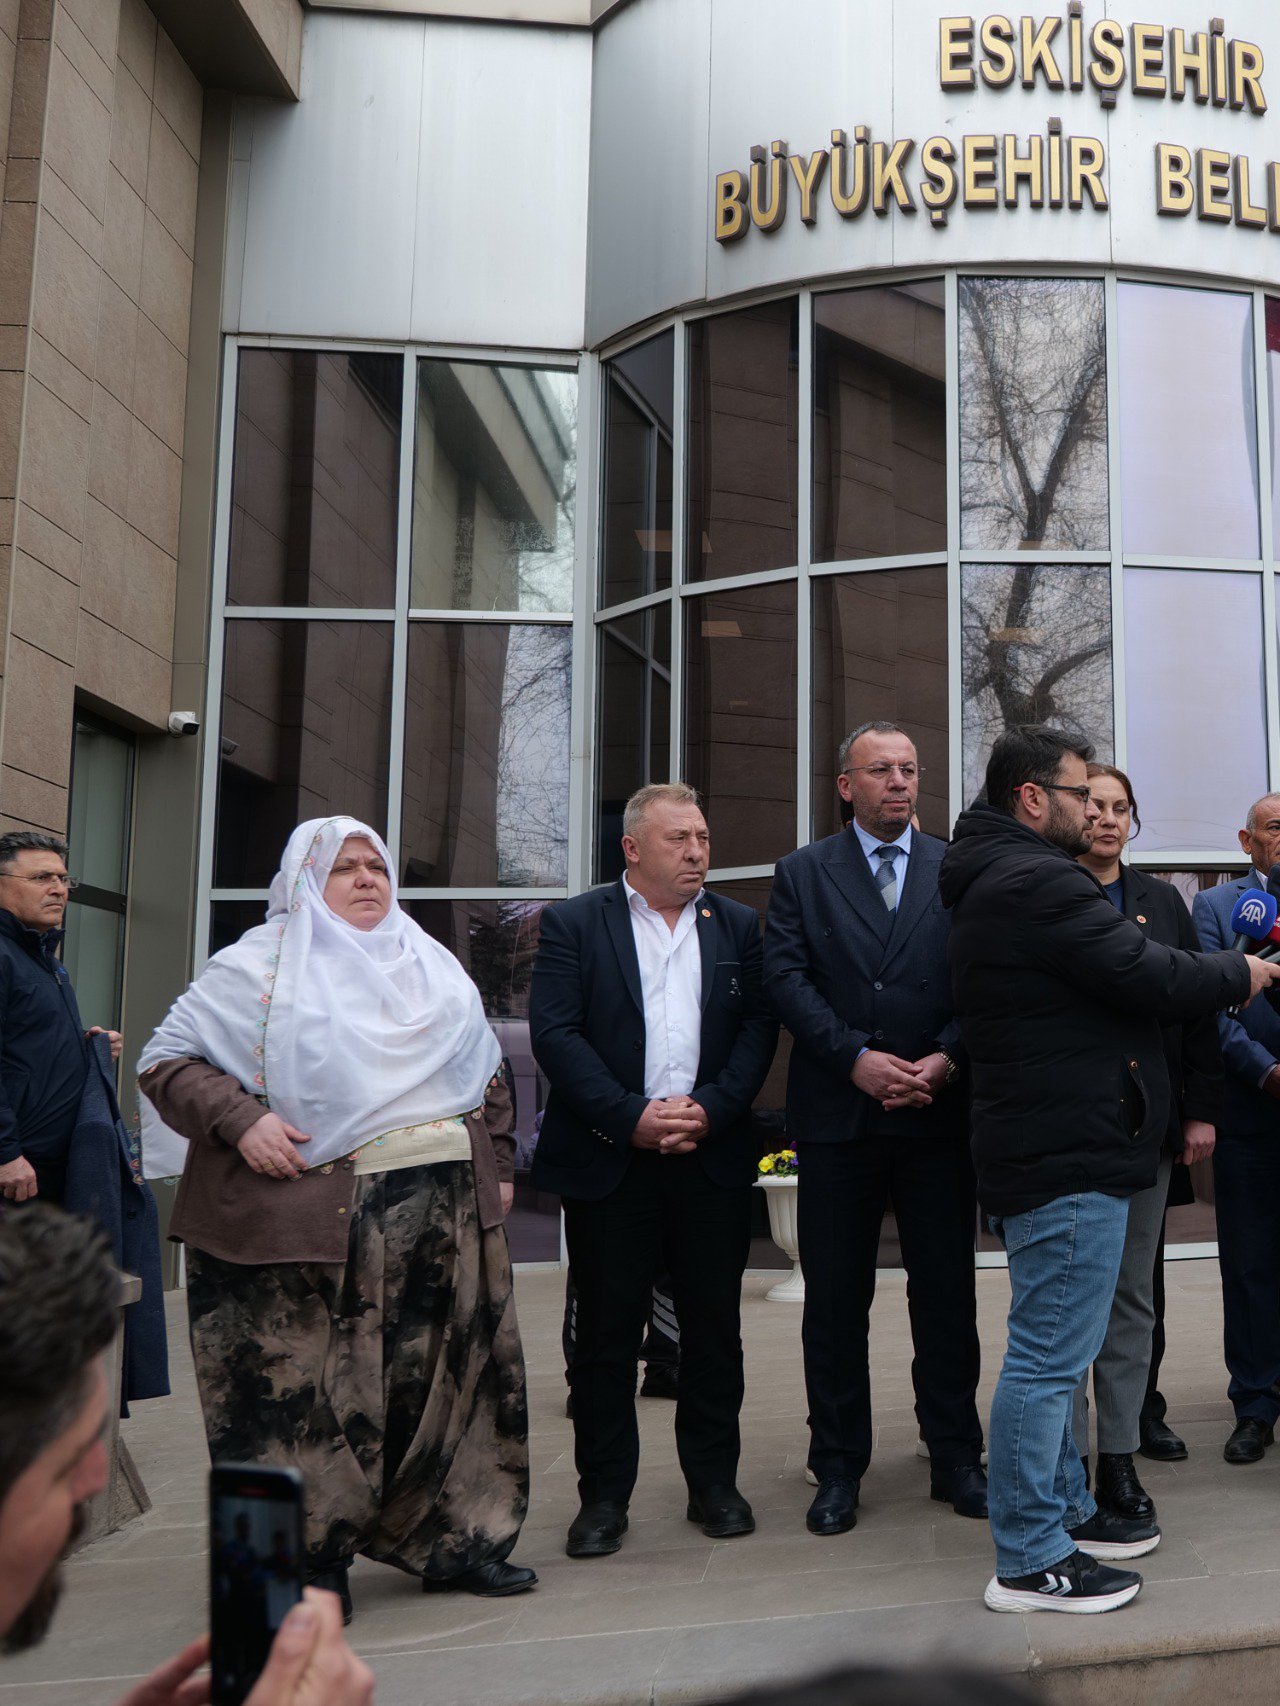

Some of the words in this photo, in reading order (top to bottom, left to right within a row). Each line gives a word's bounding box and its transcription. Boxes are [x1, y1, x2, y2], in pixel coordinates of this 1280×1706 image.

[938, 0, 1269, 116] ESKİŞEHİR
[714, 117, 1109, 245] BÜYÜKŞEHİR
[1239, 903, 1263, 926] AA
